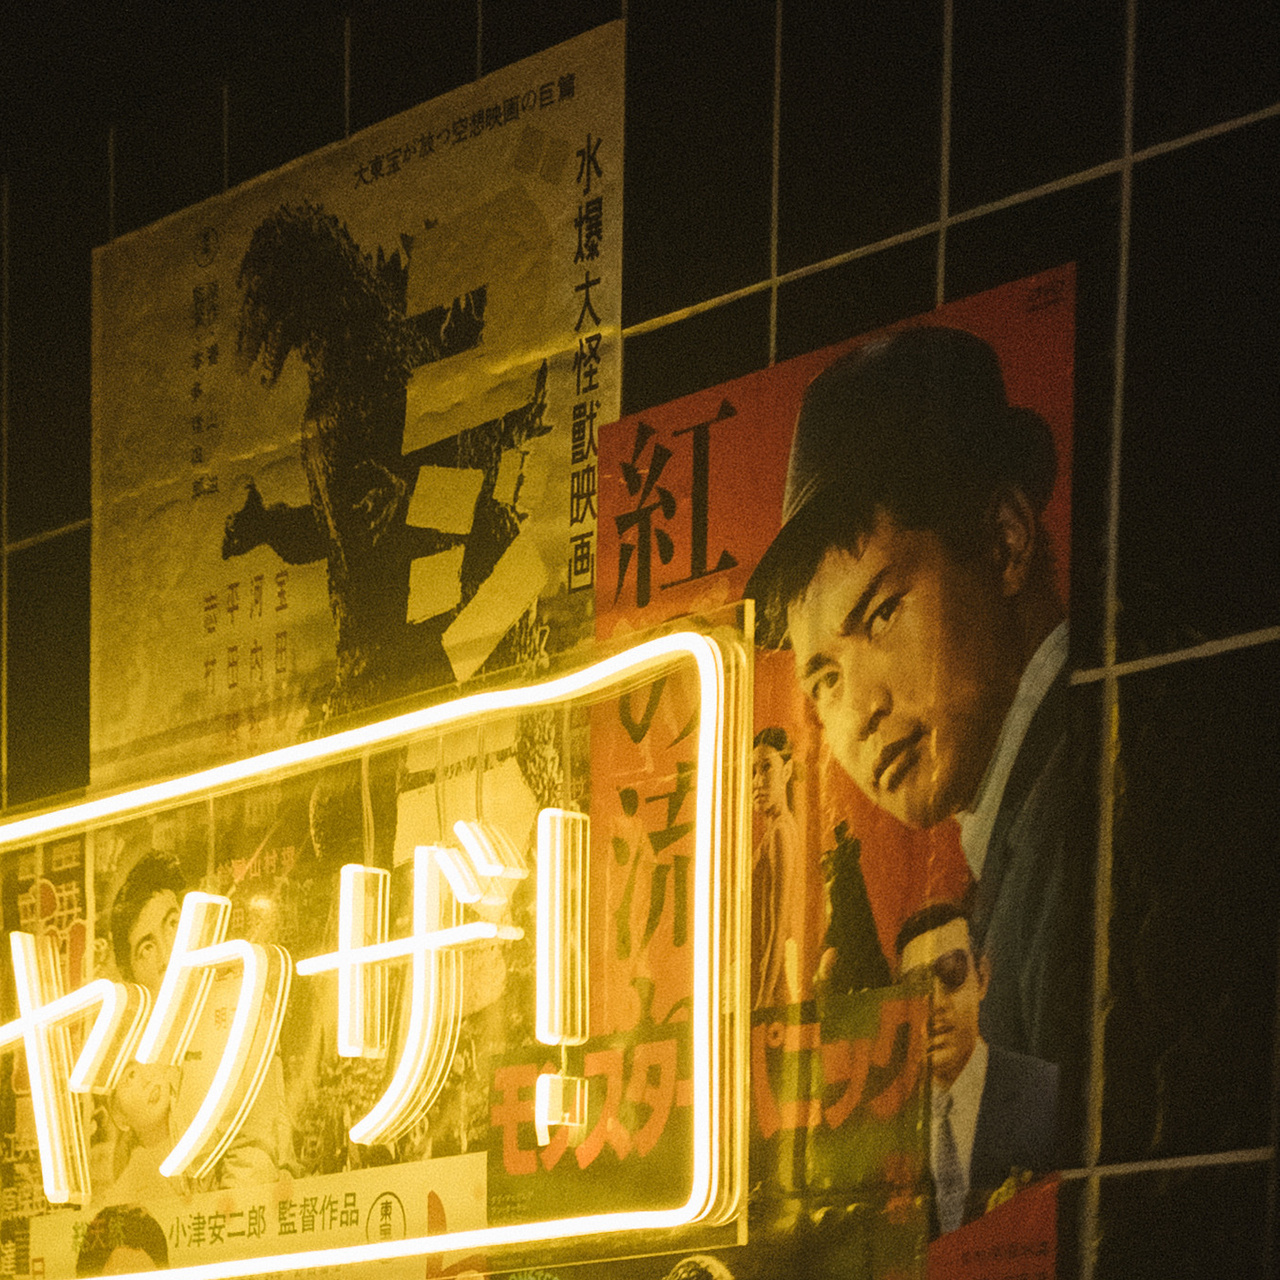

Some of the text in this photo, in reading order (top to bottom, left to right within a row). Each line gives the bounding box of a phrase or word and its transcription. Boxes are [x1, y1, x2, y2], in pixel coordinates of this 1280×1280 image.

[169, 1192, 360, 1249] 小津安二郎 監督作品
